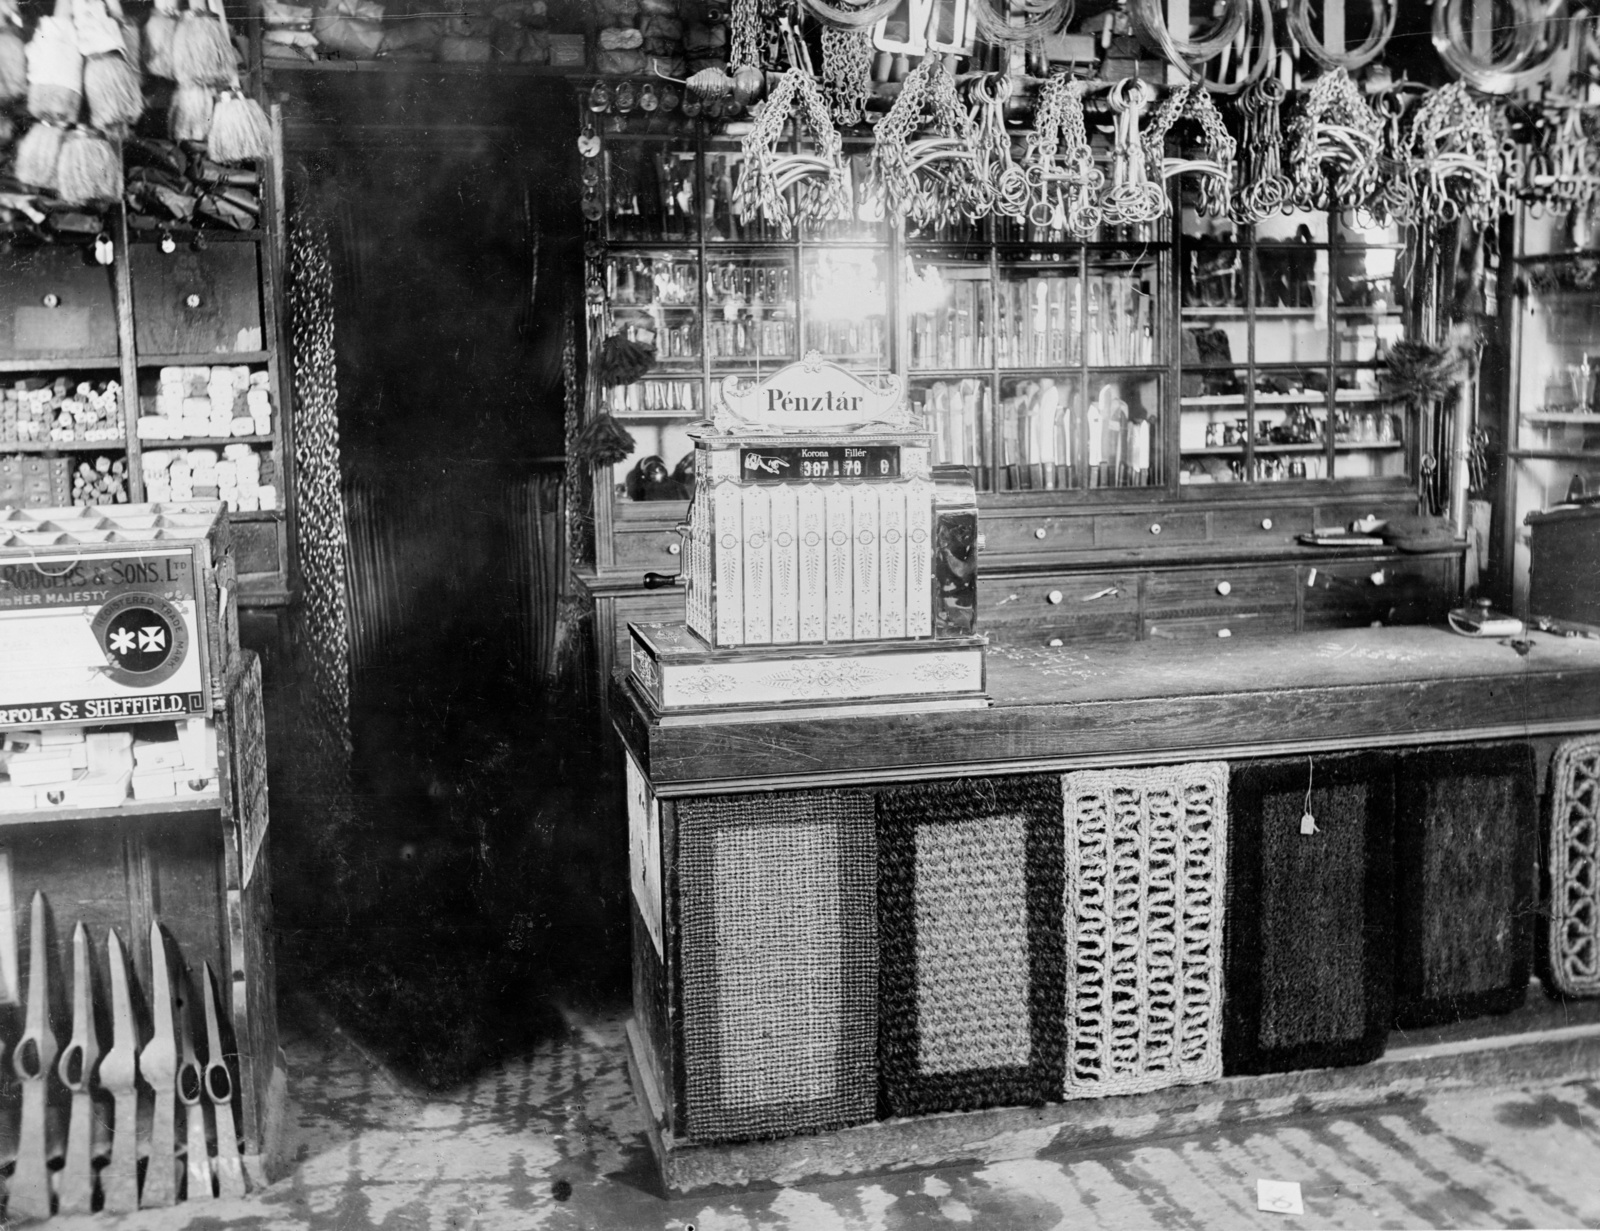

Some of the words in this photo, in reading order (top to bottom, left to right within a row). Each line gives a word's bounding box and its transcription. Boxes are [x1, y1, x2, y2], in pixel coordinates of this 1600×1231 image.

[766, 388, 863, 412] Pénztár
[801, 448, 829, 458] Korona
[845, 447, 867, 458] Fillér
[3, 565, 87, 590] RODGERS
[92, 566, 106, 585] &
[13, 594, 42, 606] HER
[45, 590, 109, 604] MAJESTY
[160, 603, 183, 633] TRADE
[167, 641, 185, 669] MARK
[85, 695, 187, 718] SHEFFIELD.
